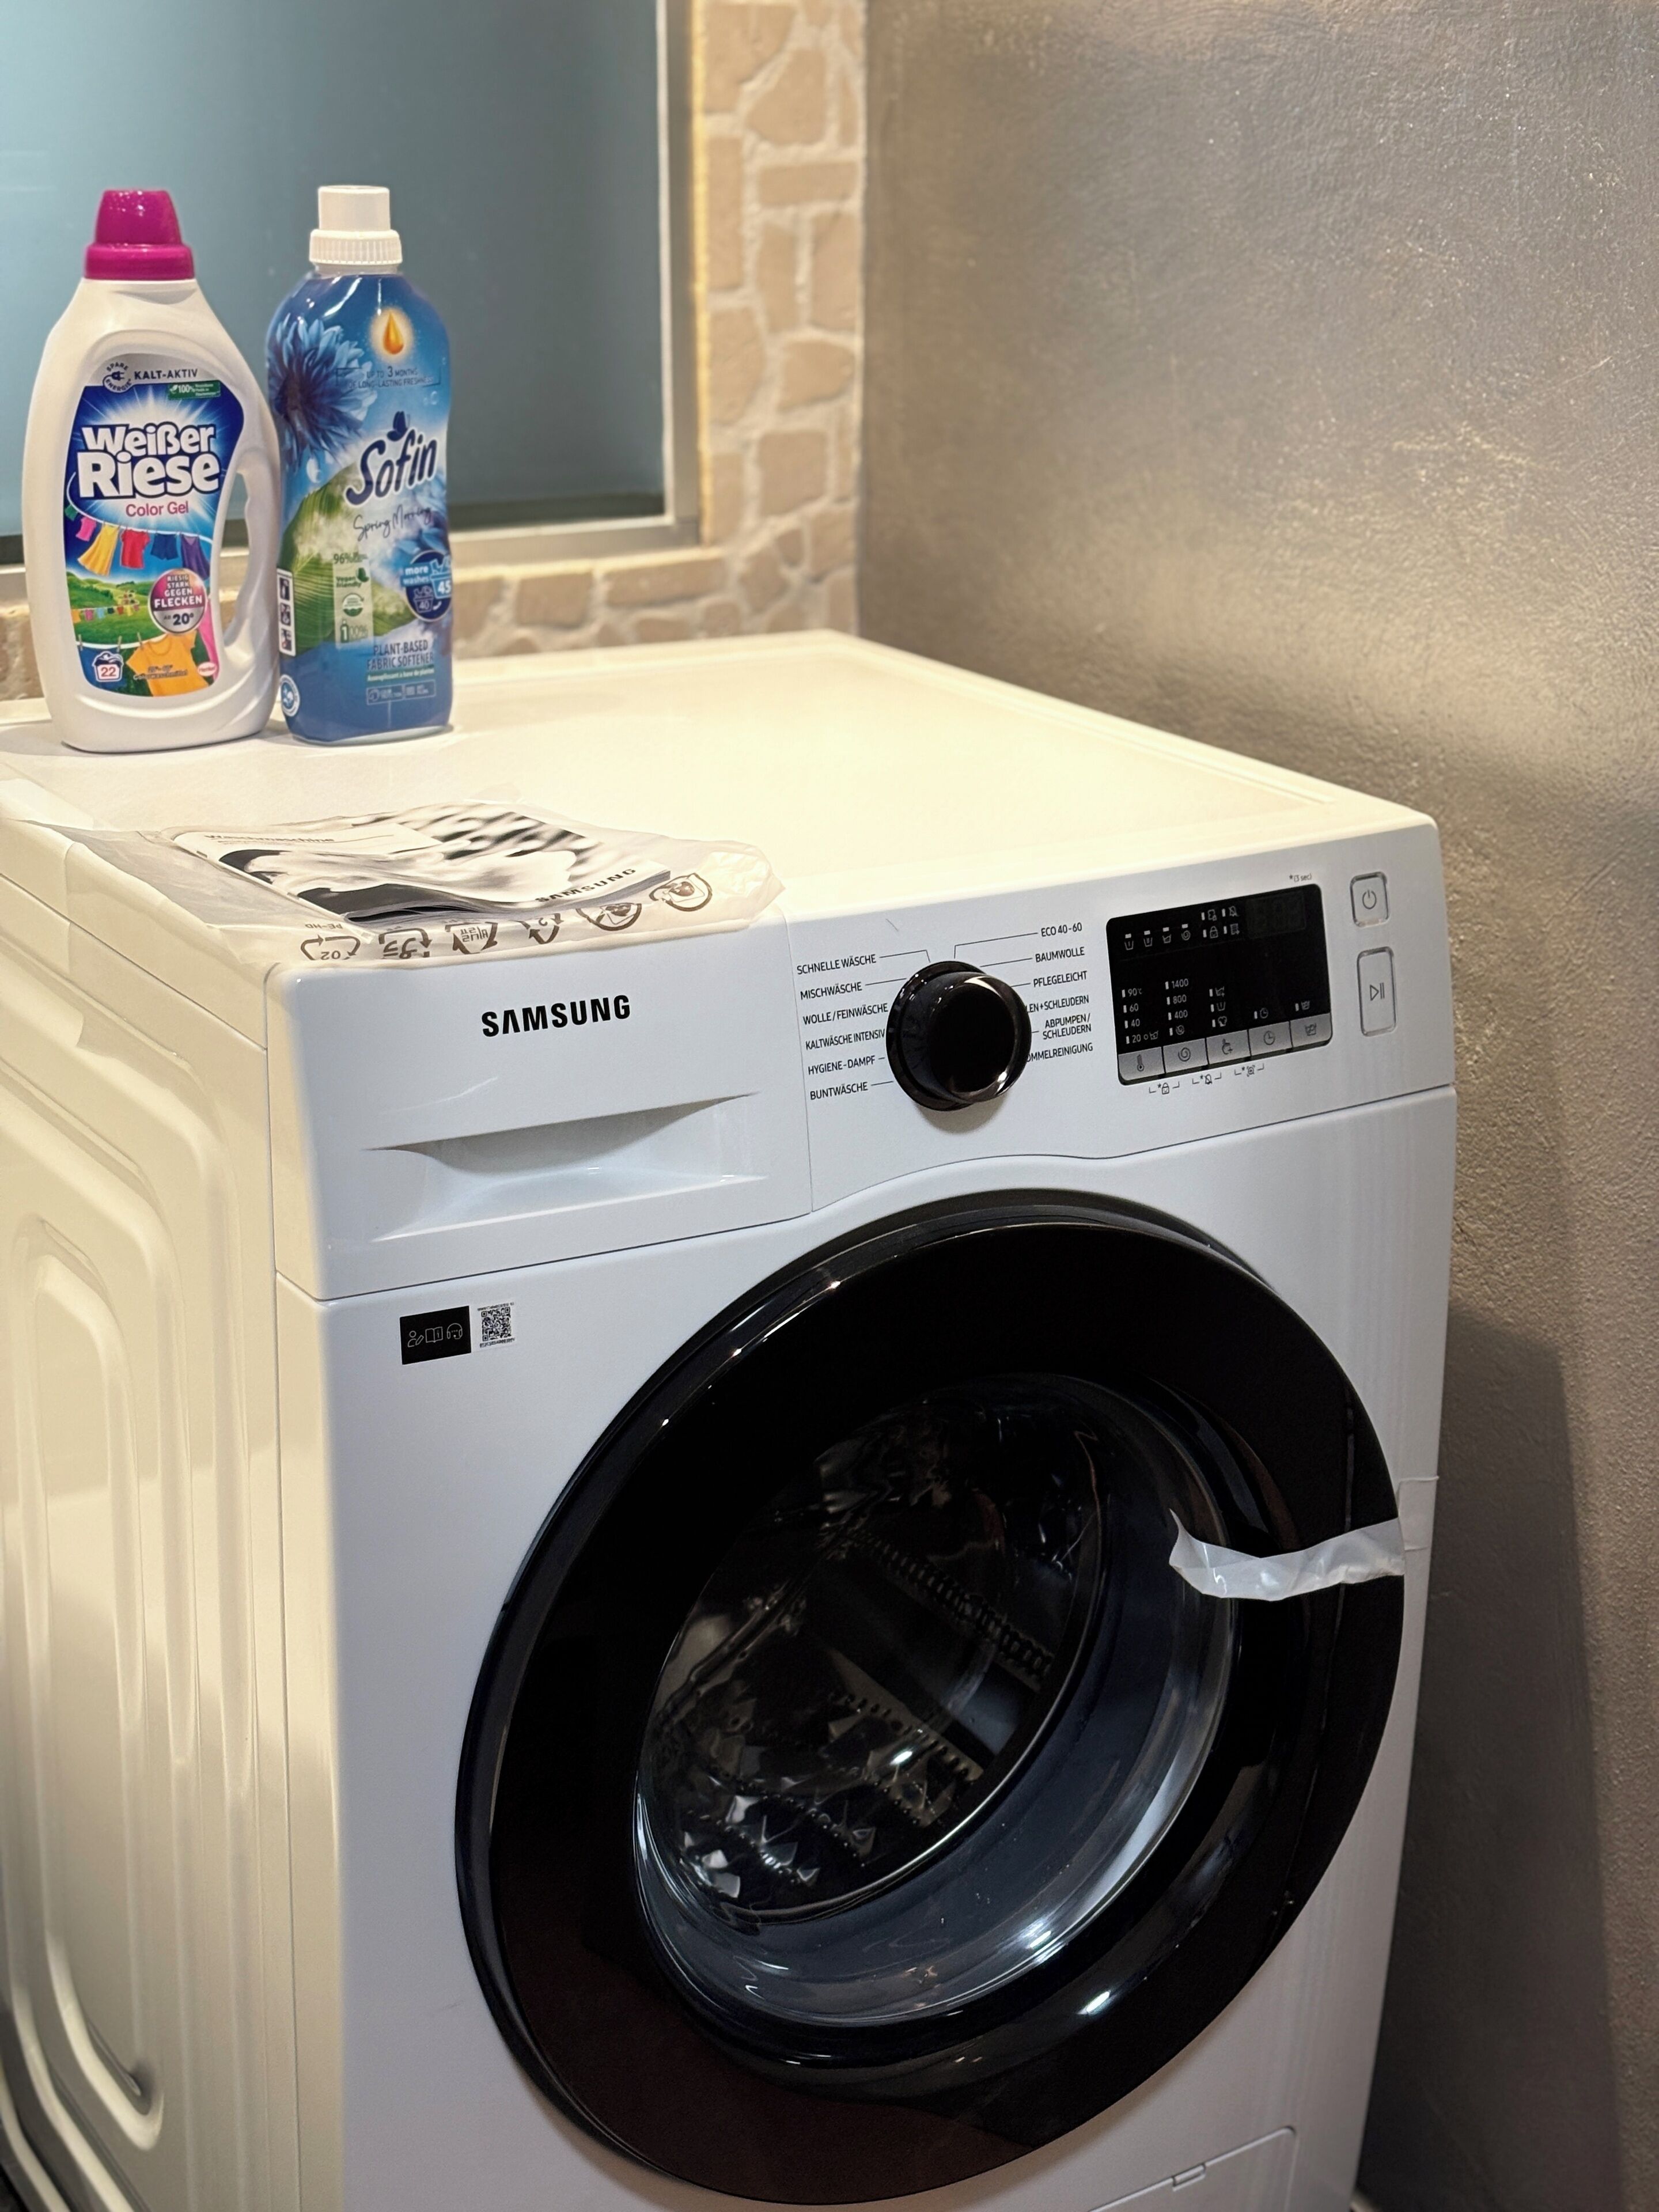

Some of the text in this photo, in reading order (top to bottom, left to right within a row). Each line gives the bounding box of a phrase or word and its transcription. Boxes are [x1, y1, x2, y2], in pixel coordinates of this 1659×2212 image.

[107, 362, 128, 372] SPARE
[134, 369, 198, 380] KALT-AKTIV
[388, 366, 393, 377] 3
[395, 368, 418, 377] MONTHS
[177, 384, 196, 394] 100%
[81, 423, 215, 457] Weißer
[77, 451, 220, 498] Riese
[346, 429, 437, 505] Sofin
[126, 501, 189, 517] Color Gel
[353, 503, 431, 542] Spring Morning
[333, 552, 353, 565] 96%
[405, 566, 429, 575] more
[403, 575, 430, 585] washes
[438, 581, 452, 594] 45
[164, 588, 192, 597] GEGEN
[154, 595, 203, 608] FLECKEN
[419, 601, 430, 609] 40
[173, 613, 194, 626] 20°
[373, 639, 429, 656] PLANT-BASED
[367, 652, 434, 671] FABRIC SOFTENER
[101, 666, 116, 677] 22
[535, 868, 636, 903] SAMSUNG
[1041, 922, 1082, 937] ECO 40-60
[320, 950, 341, 959] 02
[1035, 946, 1085, 963] BAUMWOLLE
[797, 954, 877, 975] SCHNELLE WÄSCHE
[1033, 971, 1087, 988] PFLEGELEICHT
[1171, 978, 1189, 989] 1400
[800, 982, 862, 1000] MISCHWÄSCHE
[1025, 994, 1089, 1013] LEN+SCHLEUDERN
[1173, 994, 1187, 1004] 800
[1129, 1003, 1139, 1013] 60
[1174, 1009, 1188, 1019] 400
[481, 995, 631, 1037] SAMSUNG
[1045, 1013, 1090, 1029] ABPUMPEN/
[1131, 1018, 1141, 1027] 40
[805, 1028, 885, 1050] KALTWÄSCHE INTENSIV
[1043, 1024, 1092, 1040] SCHLEUDERN
[1131, 1034, 1141, 1043] 20
[1027, 1042, 1093, 1062] OMMELREINIGUNG
[808, 1055, 876, 1075] HYGIENE-DAMPF
[810, 1082, 869, 1100] BUNTWÄSCHE
